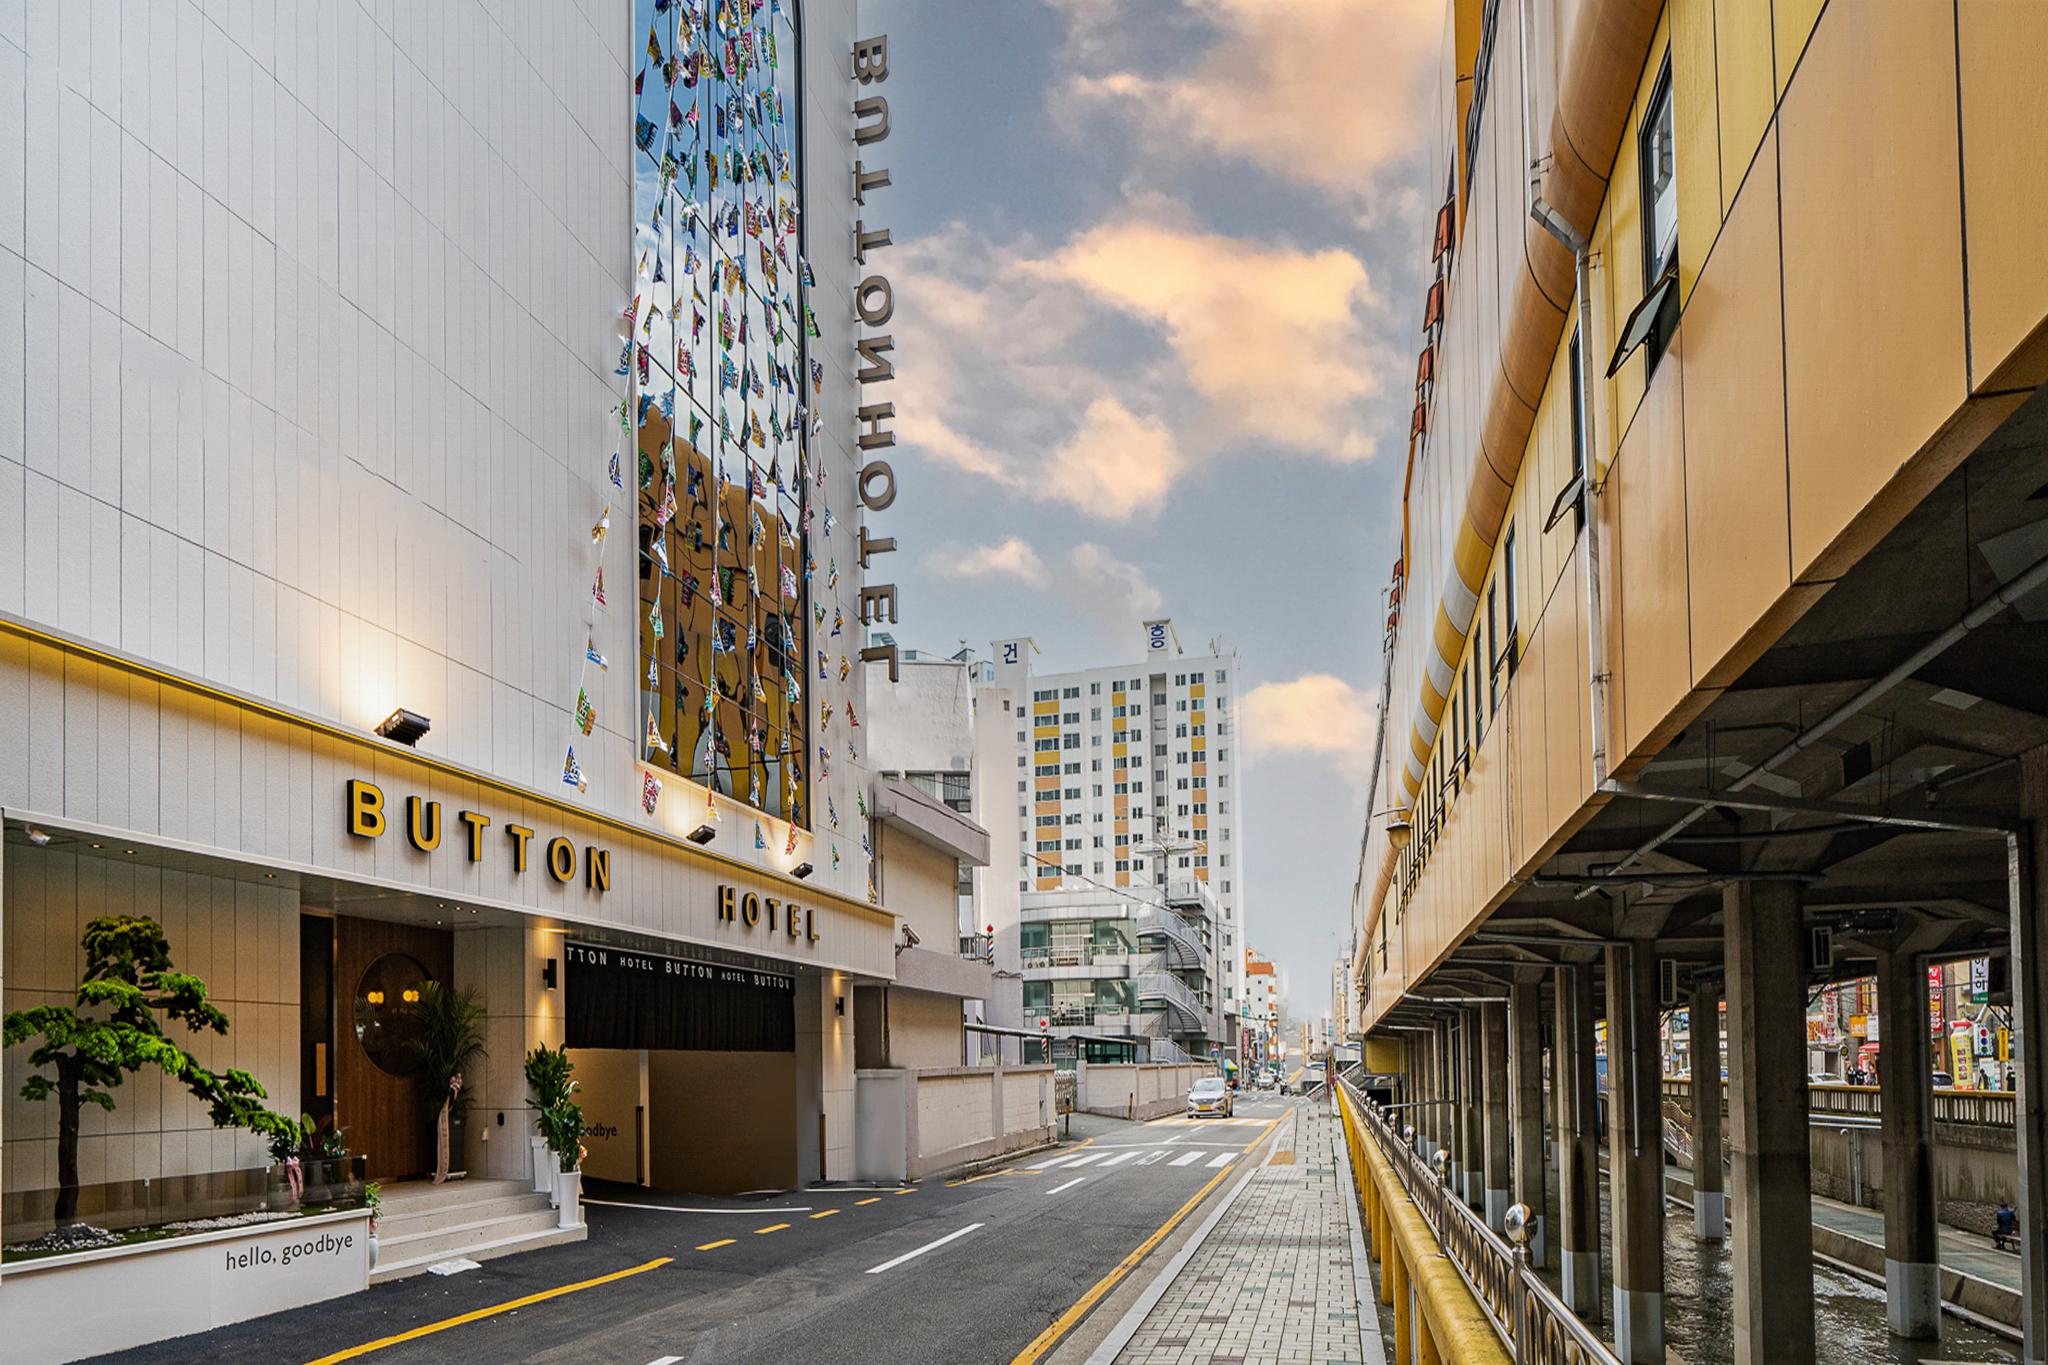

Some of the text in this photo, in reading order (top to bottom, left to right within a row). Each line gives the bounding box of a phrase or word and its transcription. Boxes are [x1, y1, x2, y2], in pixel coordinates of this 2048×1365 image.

[1003, 643, 1018, 665] 건
[347, 779, 611, 892] BUTTON
[718, 884, 821, 941] HOTEL
[620, 957, 654, 971] HOTEL
[665, 961, 713, 980] BUTTON
[721, 973, 747, 983] HOTEL
[579, 1122, 617, 1141] oodbye
[227, 1233, 353, 1271] hello, goodbye
